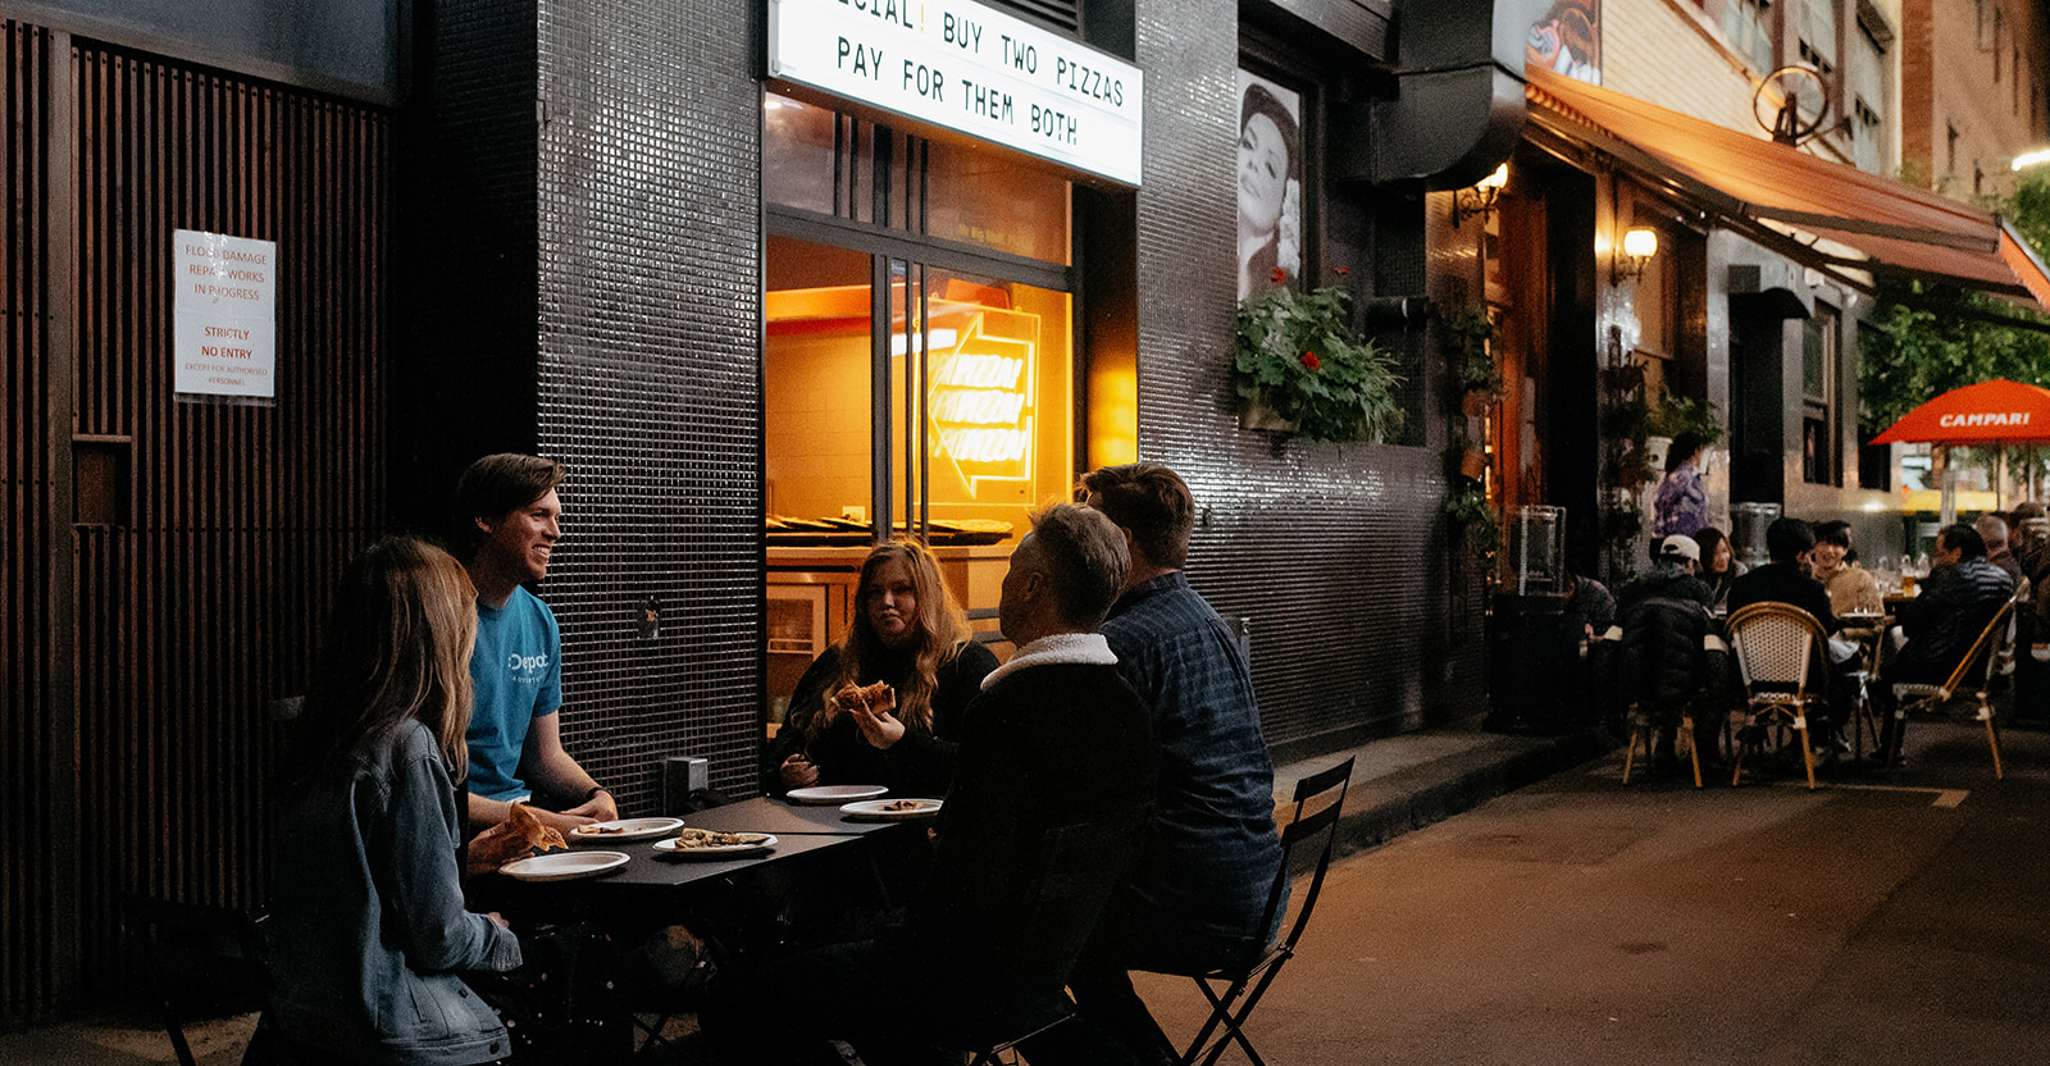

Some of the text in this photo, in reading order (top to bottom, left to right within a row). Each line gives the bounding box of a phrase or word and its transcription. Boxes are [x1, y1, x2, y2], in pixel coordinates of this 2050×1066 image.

[838, 0, 1123, 107] IAL! BUY TWO PIZZAS
[838, 36, 1077, 146] PAY FOR THEM BOTH
[223, 249, 267, 265] DAMAGE
[189, 263, 265, 283] REPA WORKS
[194, 283, 206, 295] IN
[204, 326, 250, 341] STRICTLY
[201, 346, 253, 360] NO ENTRY
[1939, 412, 2031, 428] CAMPARI
